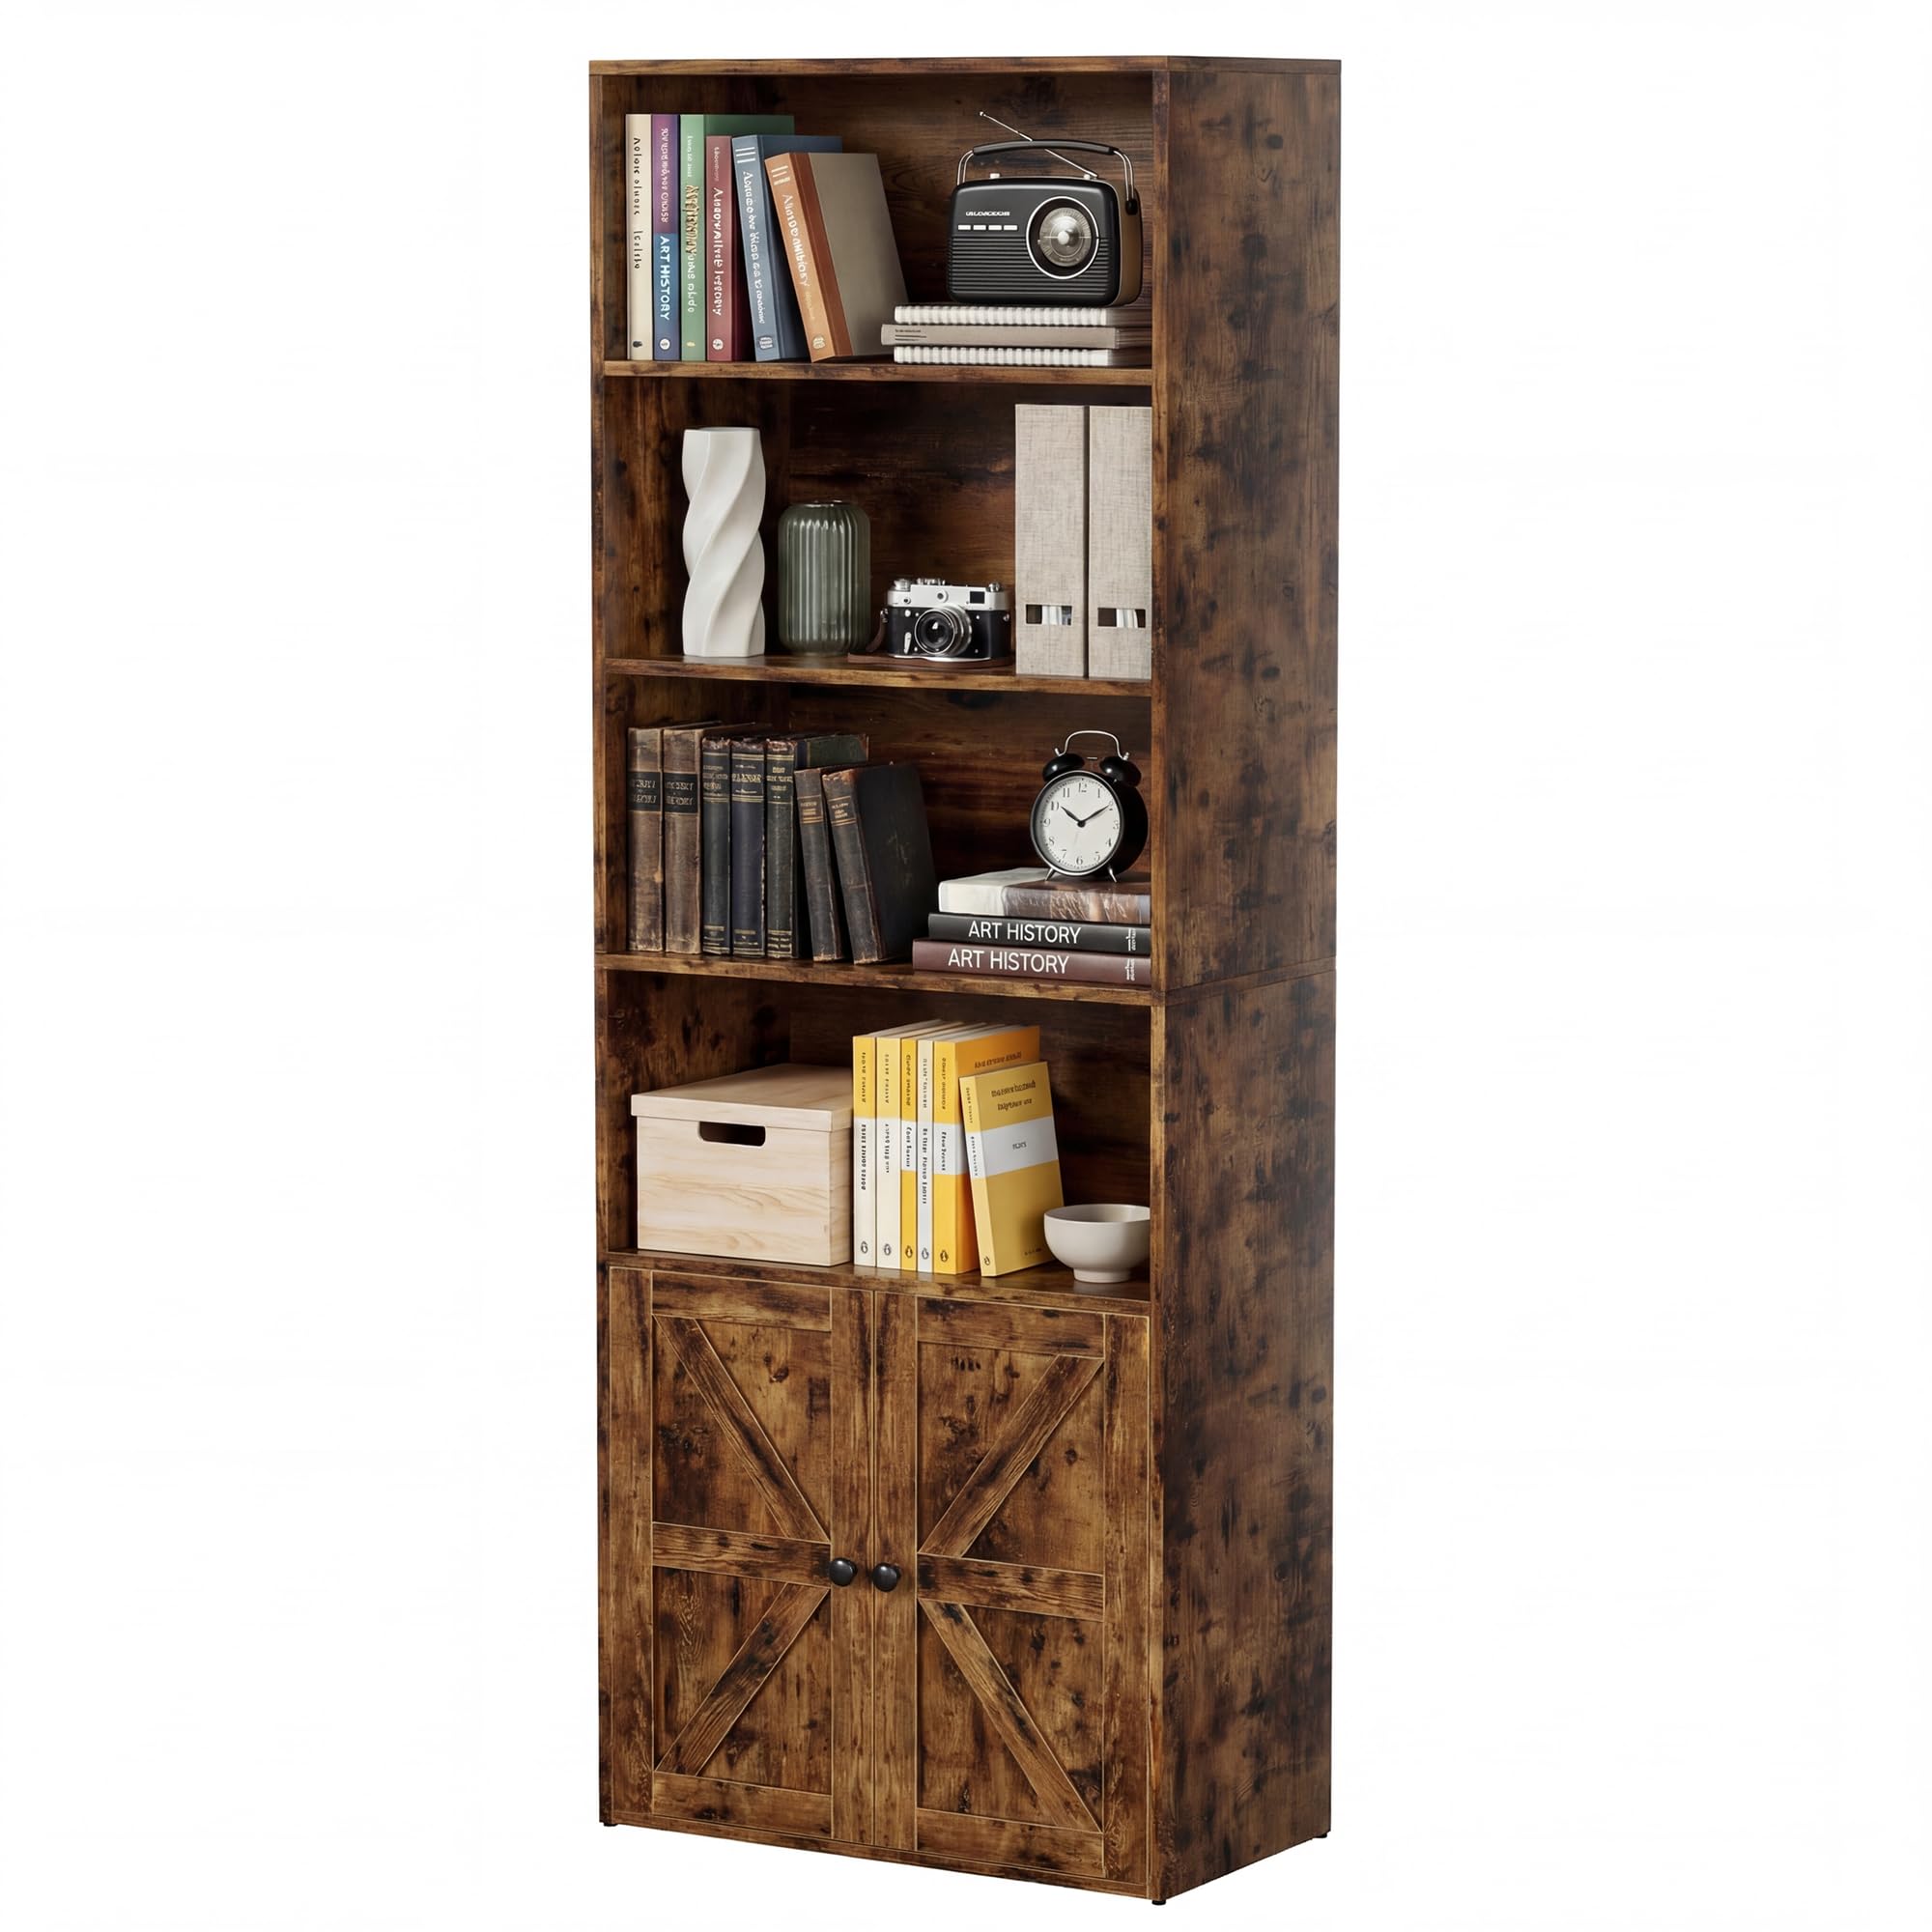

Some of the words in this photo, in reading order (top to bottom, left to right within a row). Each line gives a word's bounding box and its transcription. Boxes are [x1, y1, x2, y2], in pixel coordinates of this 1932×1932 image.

[660, 236, 670, 262] ART
[660, 264, 670, 321] HISTORY
[968, 920, 1002, 939] ART
[1007, 923, 1082, 944] HISTORY
[948, 948, 984, 968] ART
[990, 952, 1069, 974] HISTORY
